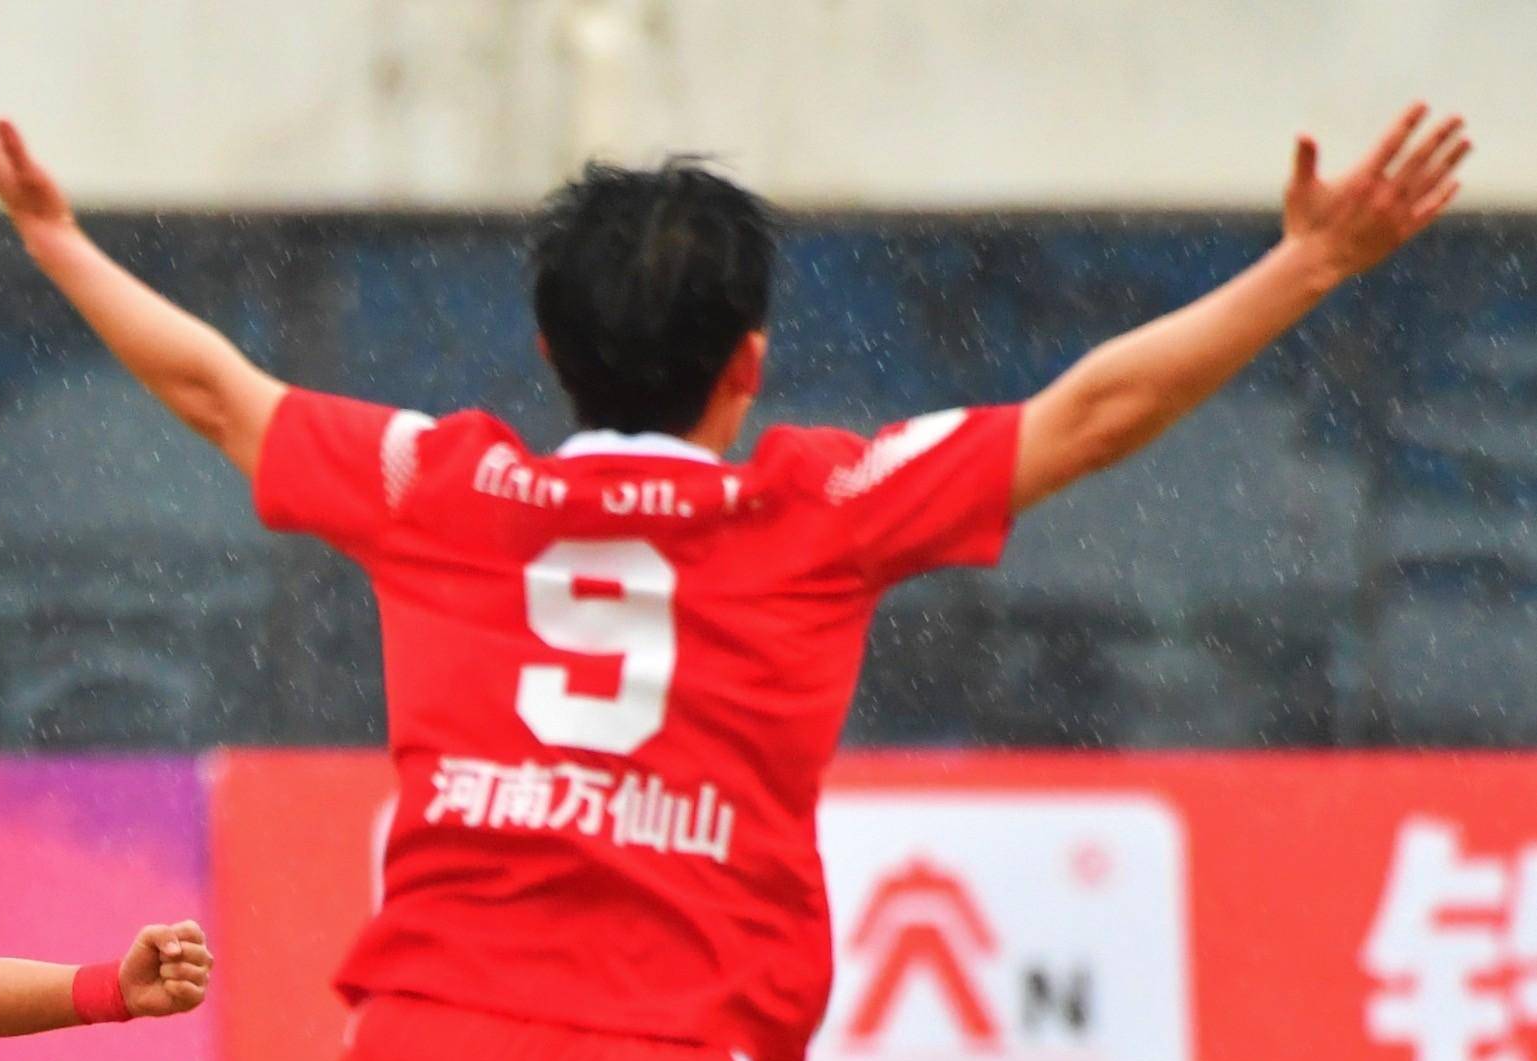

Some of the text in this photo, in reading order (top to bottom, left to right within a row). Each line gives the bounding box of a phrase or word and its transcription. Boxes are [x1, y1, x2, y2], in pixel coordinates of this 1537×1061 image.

[516, 538, 677, 755] 9
[424, 756, 734, 864] 河南万仙山
